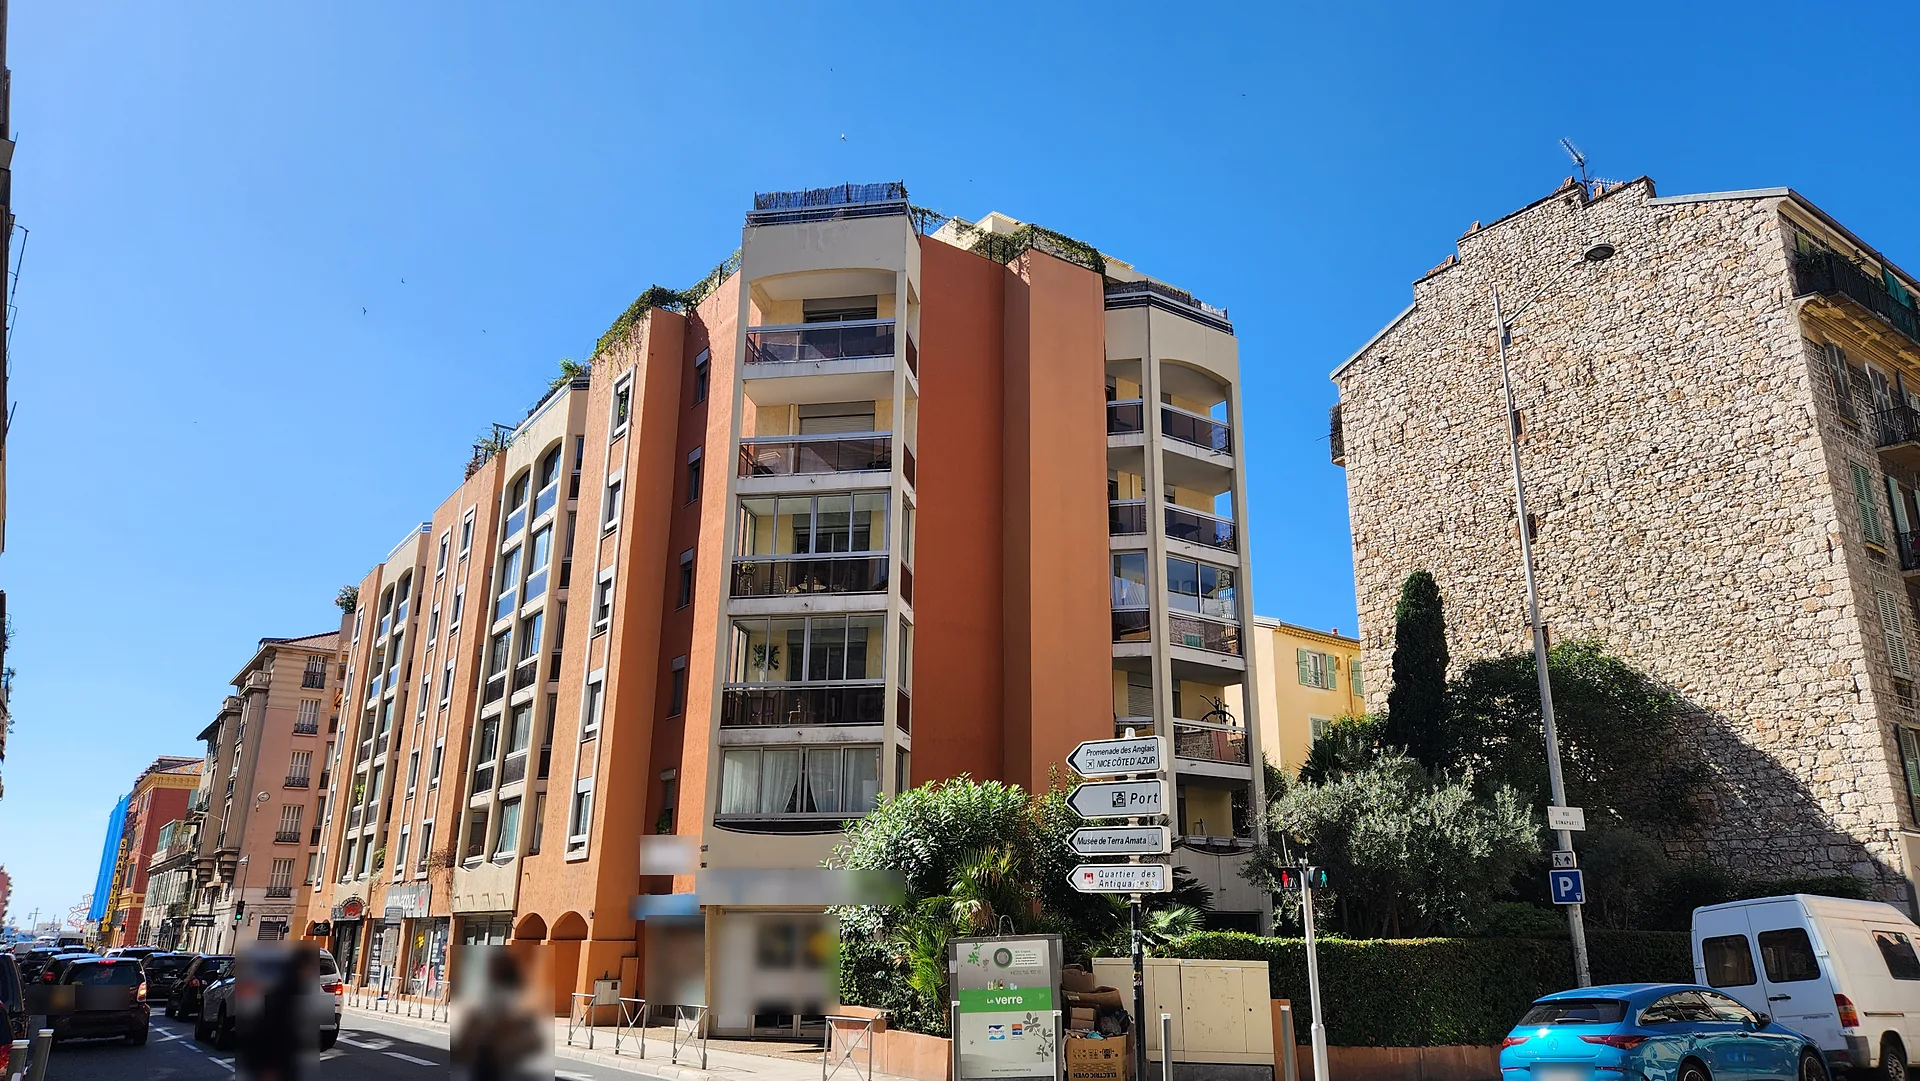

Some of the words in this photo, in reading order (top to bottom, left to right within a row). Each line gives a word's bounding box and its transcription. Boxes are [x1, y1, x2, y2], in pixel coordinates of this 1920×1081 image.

[1086, 746, 1119, 756] Promenade
[1120, 745, 1131, 754] des
[1132, 744, 1155, 754] Anglais
[1112, 757, 1130, 766] CÔTE
[1130, 792, 1158, 805] Port
[1077, 836, 1098, 845] Musée
[1098, 837, 1106, 845] de
[1108, 836, 1125, 845] Terra
[1125, 836, 1147, 845] Amata
[1098, 869, 1135, 878] Quartier
[1141, 869, 1156, 878] des
[1559, 876, 1573, 897] P
[995, 995, 1023, 1005] verre
